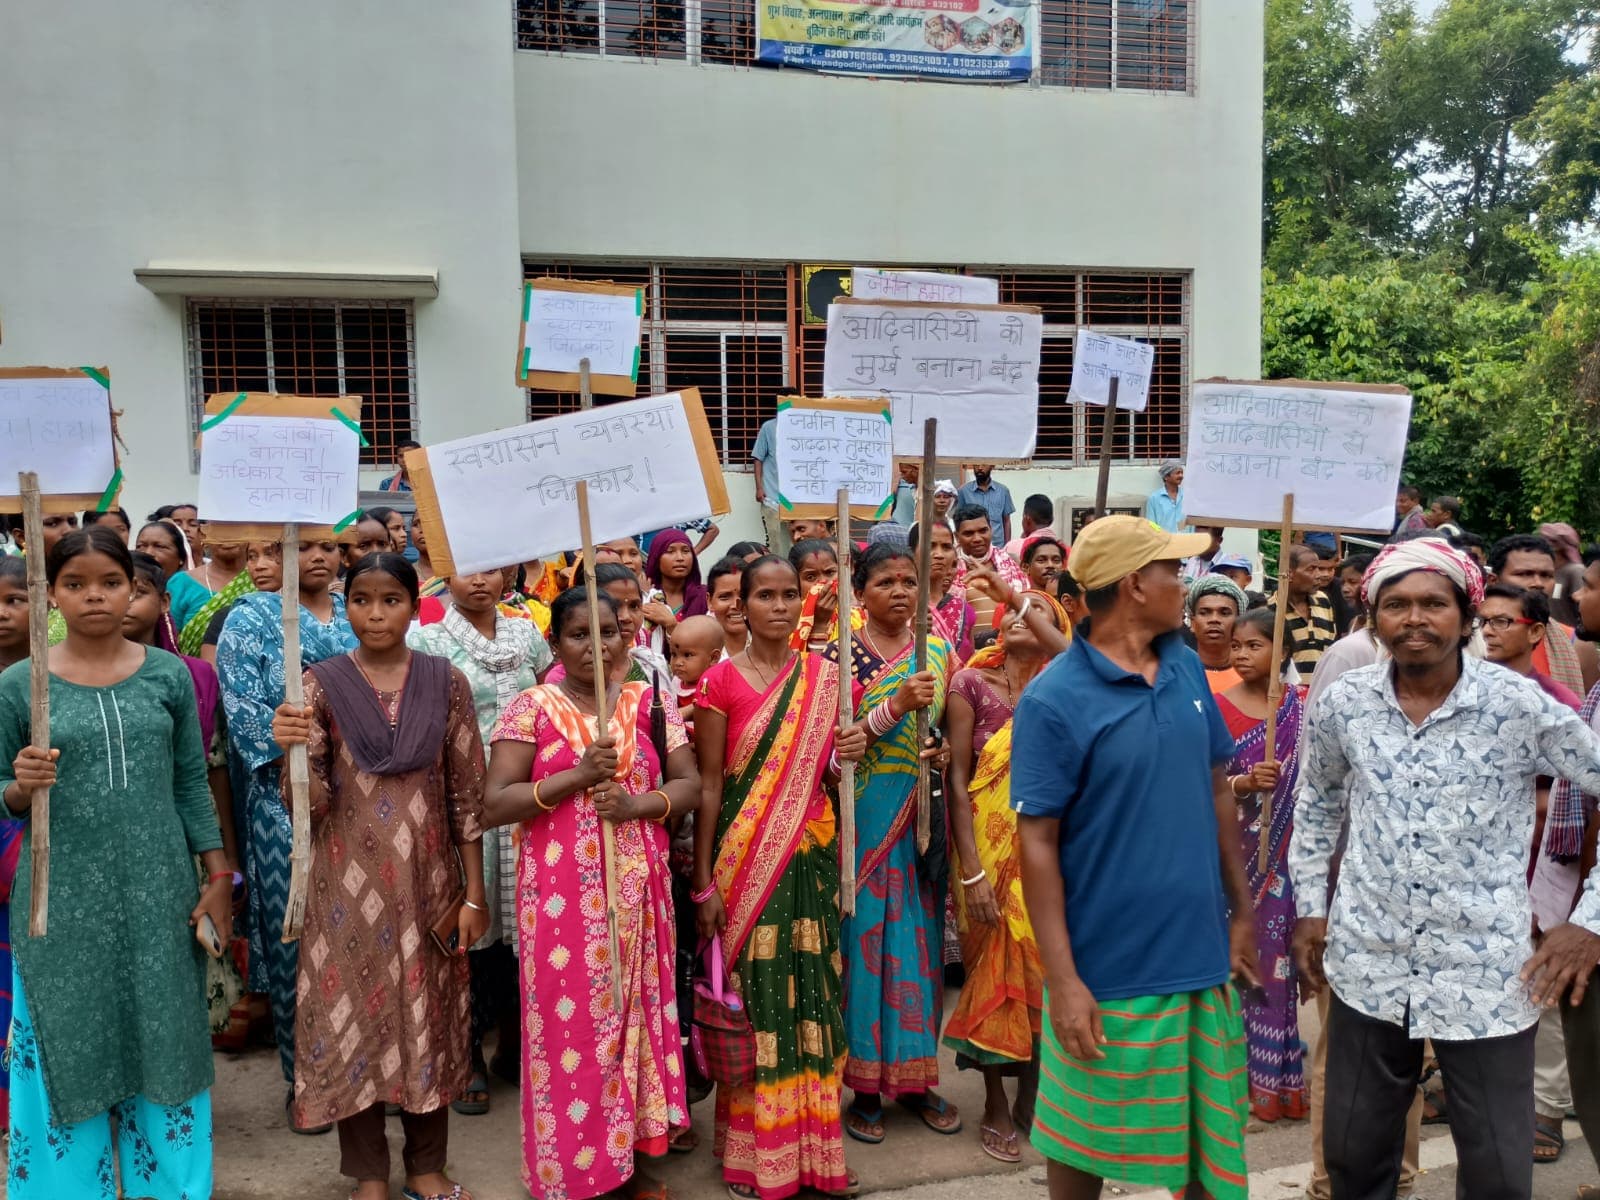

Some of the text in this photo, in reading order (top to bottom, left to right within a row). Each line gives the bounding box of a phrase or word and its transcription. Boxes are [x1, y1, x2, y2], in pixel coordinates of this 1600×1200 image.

[1000, 315, 1024, 346] को
[911, 357, 982, 382] बनाना
[988, 353, 1032, 384] बंद
[787, 411, 836, 433] जमीन
[208, 457, 288, 485] अधिकार
